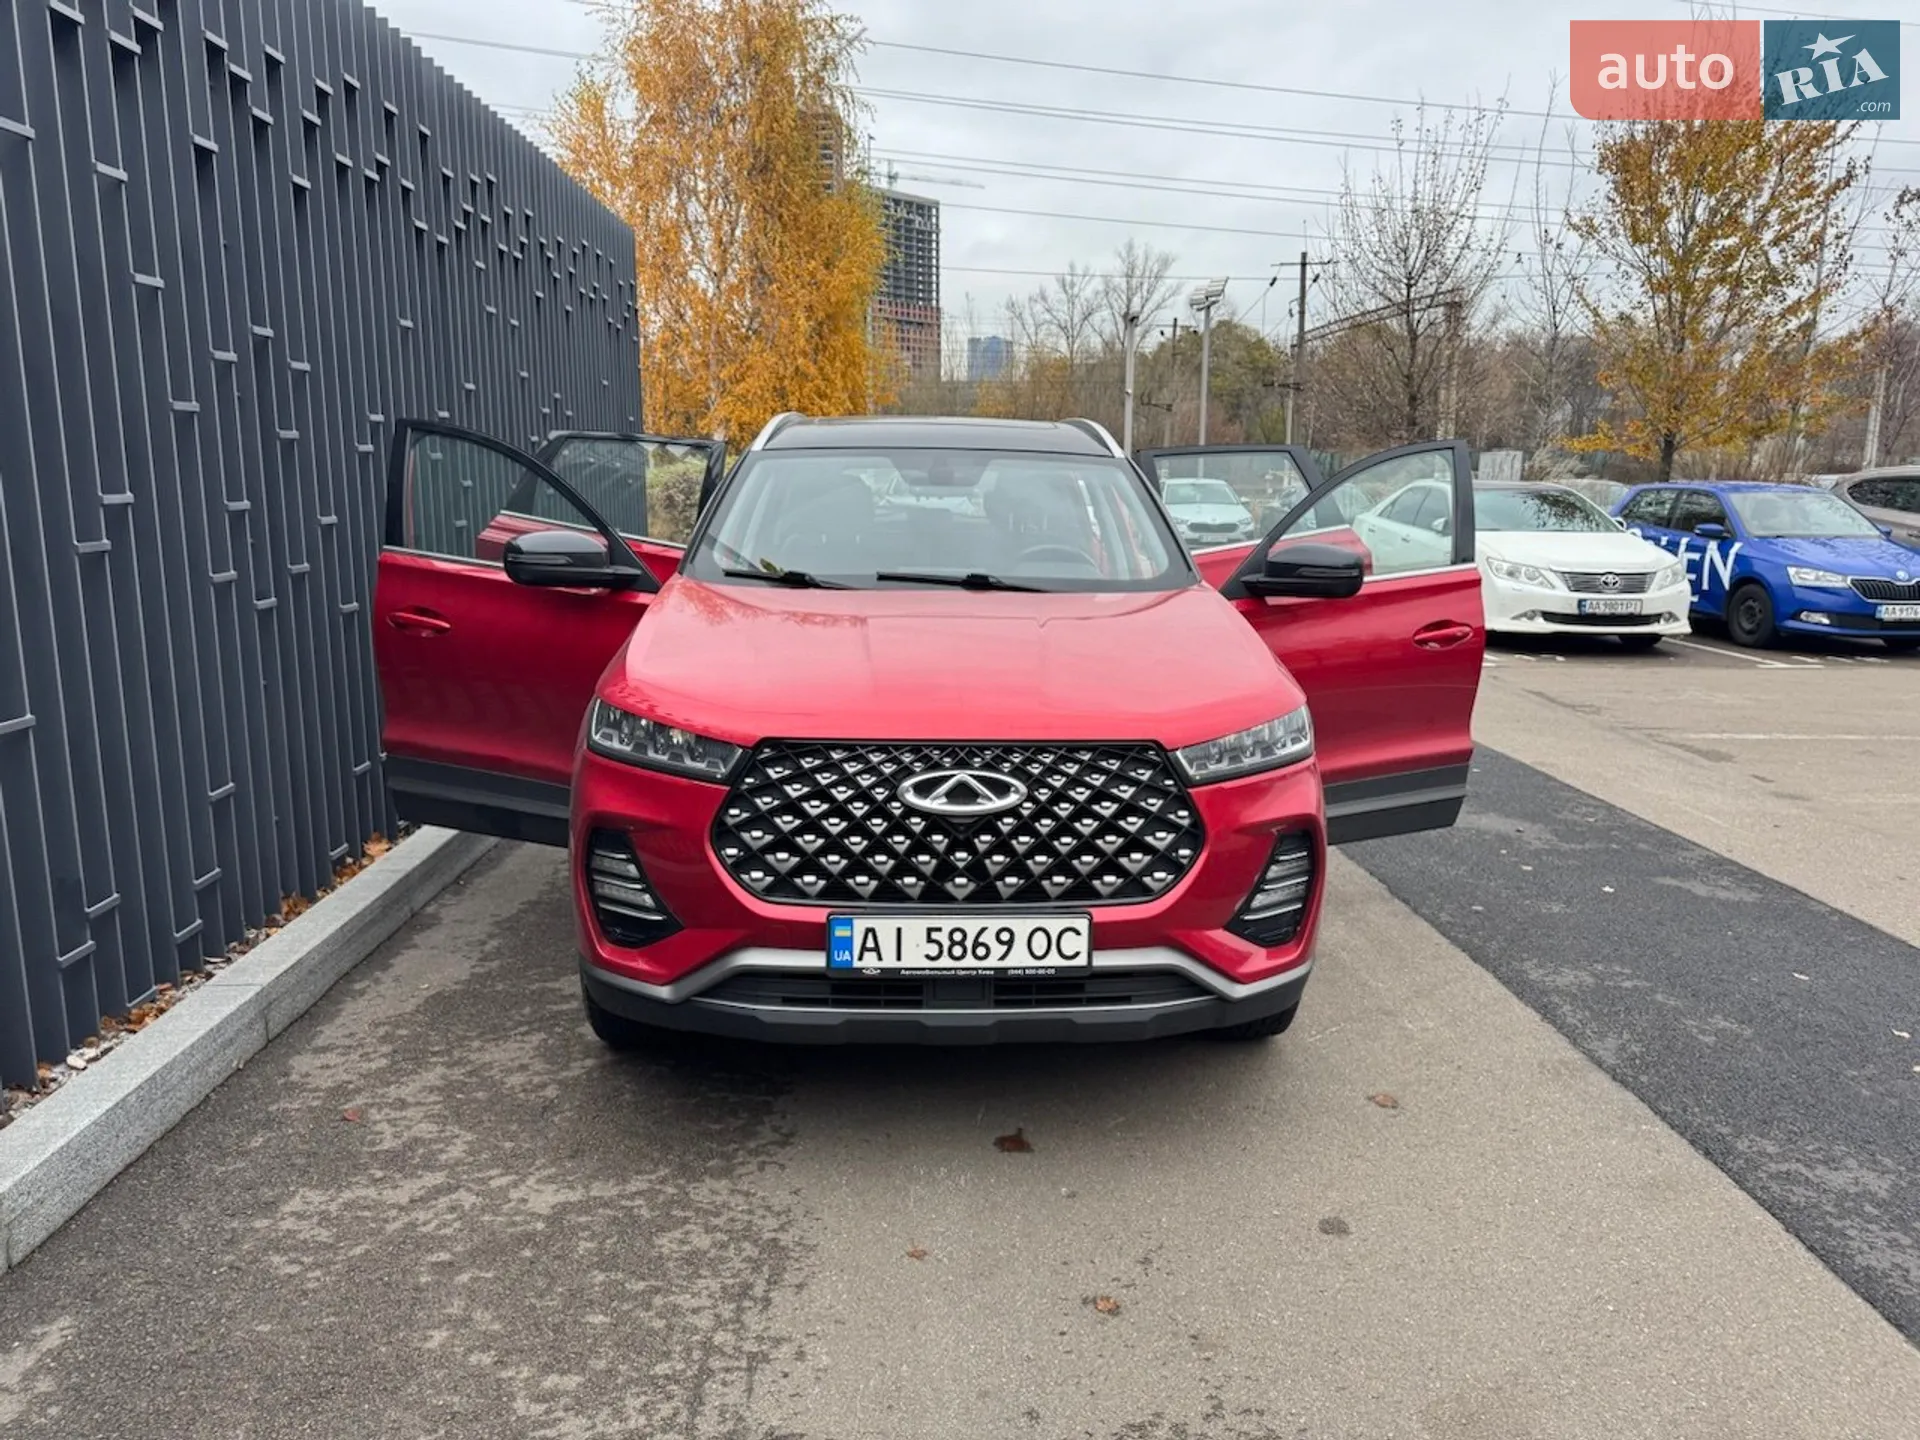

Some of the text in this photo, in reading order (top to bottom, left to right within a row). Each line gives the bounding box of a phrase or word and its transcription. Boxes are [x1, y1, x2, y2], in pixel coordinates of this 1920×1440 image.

[857, 927, 1082, 962] AI 5869 OC
[834, 951, 851, 962] UA
